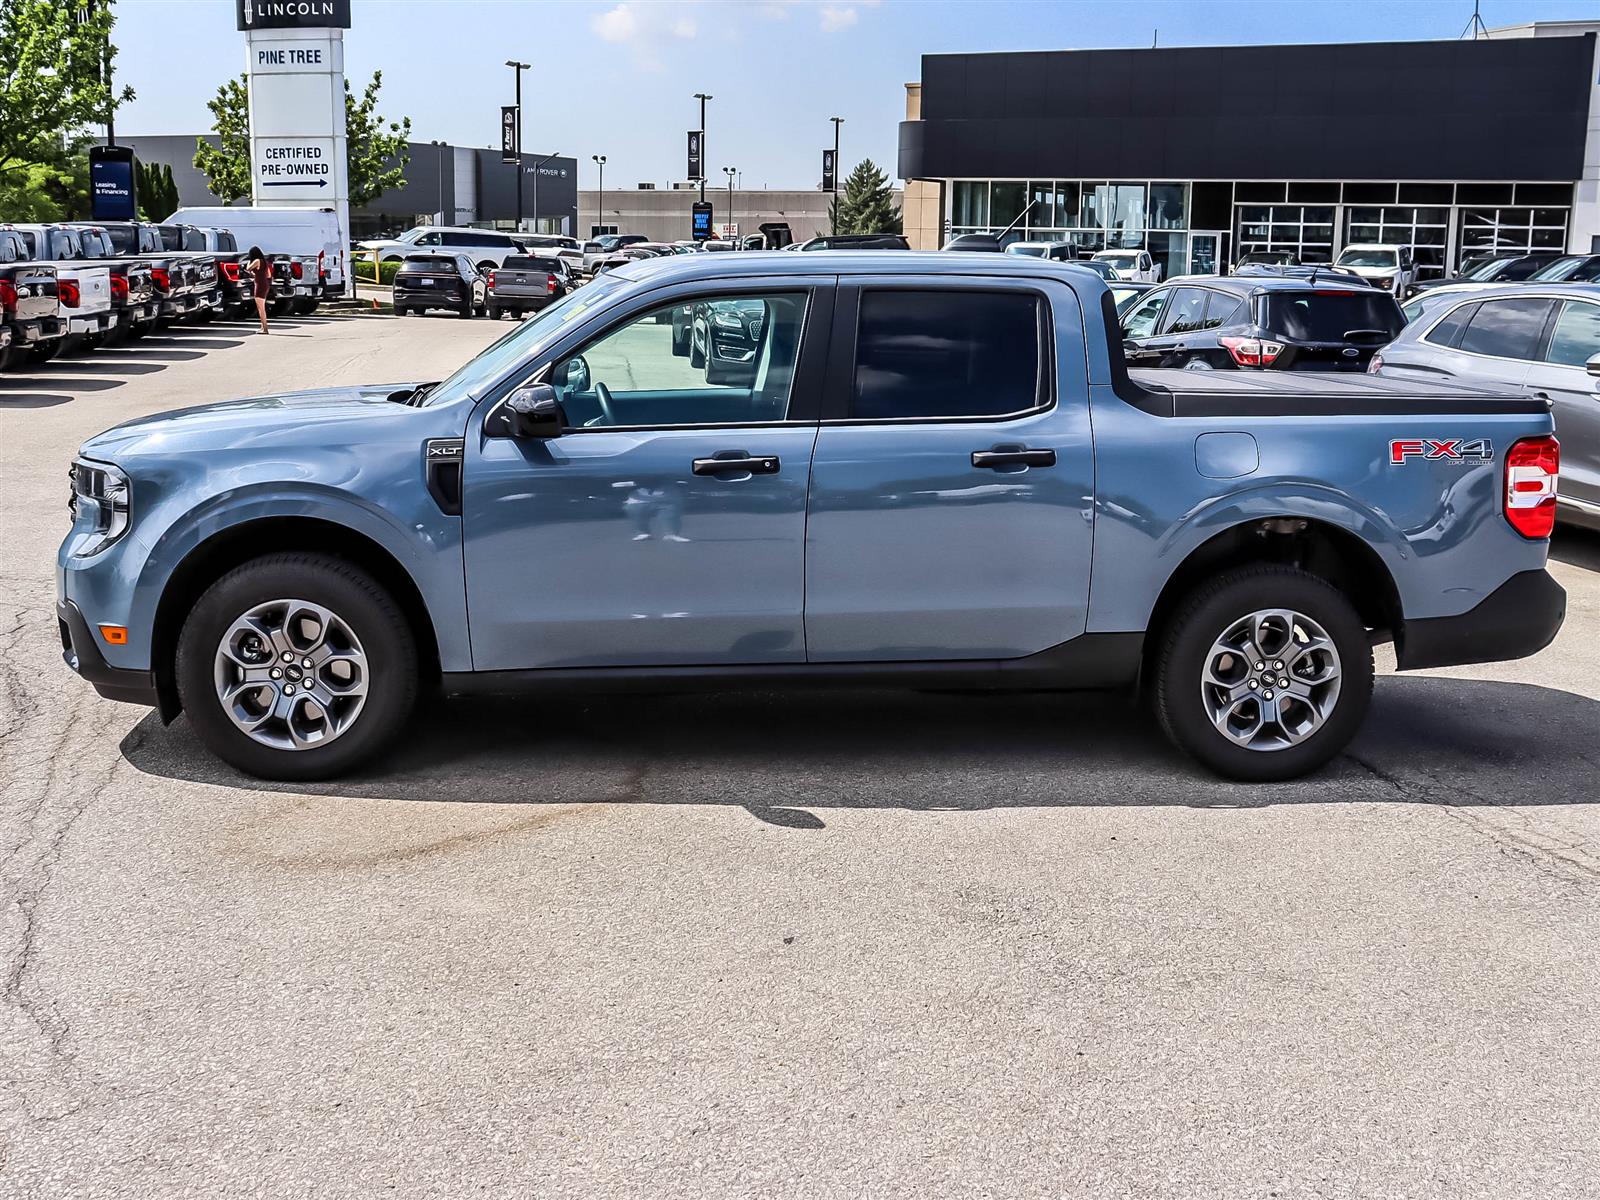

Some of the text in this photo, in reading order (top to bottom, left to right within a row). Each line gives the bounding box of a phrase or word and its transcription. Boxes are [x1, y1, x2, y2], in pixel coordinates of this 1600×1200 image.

[258, 2, 334, 17] LINCOLN
[258, 49, 322, 65] PINE TREE
[265, 147, 322, 159] CERTIFIED
[261, 163, 329, 176] PRE-OWNED
[540, 168, 559, 176] ROVER
[430, 447, 463, 456] XLT
[1389, 438, 1495, 466] FX4
